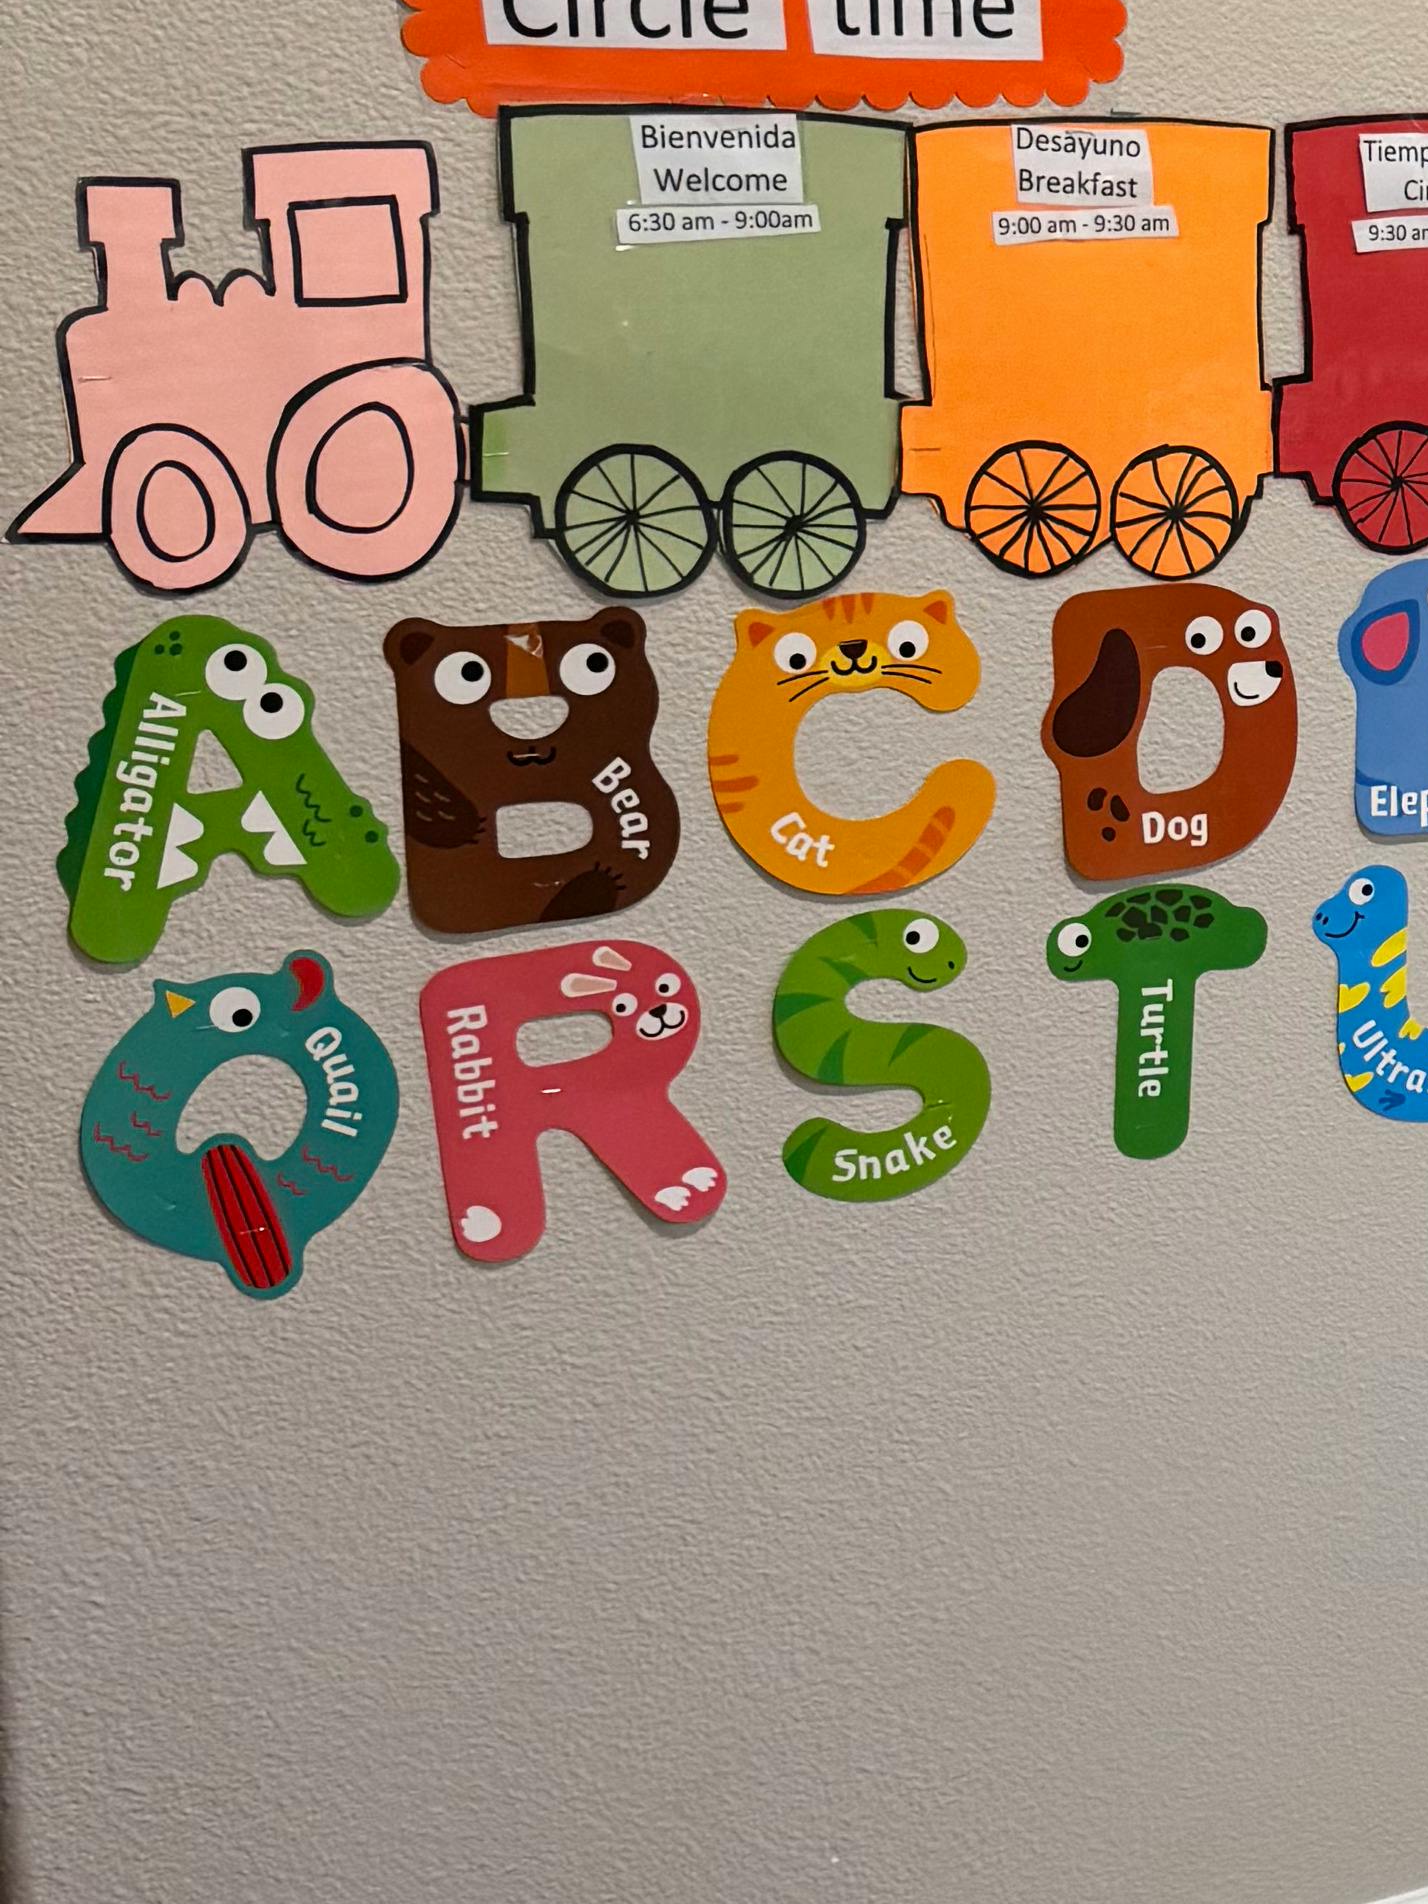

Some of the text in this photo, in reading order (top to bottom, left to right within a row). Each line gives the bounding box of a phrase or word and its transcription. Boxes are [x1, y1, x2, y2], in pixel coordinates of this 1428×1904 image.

[641, 124, 796, 150] Bienvenida
[1016, 127, 1141, 160] Desayuno
[653, 167, 788, 194] Welcome
[1018, 169, 1138, 199] Breakfast
[628, 209, 814, 233] 6:30 am 9:00am
[999, 213, 1170, 236] 9:00 am 9:30 am
[1369, 224, 1407, 241] 9:30
[104, 691, 188, 893] Alligator
[591, 756, 649, 863] Bear
[769, 811, 836, 868] Cat
[1141, 810, 1209, 847] Dog
[1140, 978, 1172, 1099] Turtle
[304, 1025, 365, 1138] Quail
[446, 1004, 498, 1140] Rabbit
[831, 1125, 957, 1183] Snake
